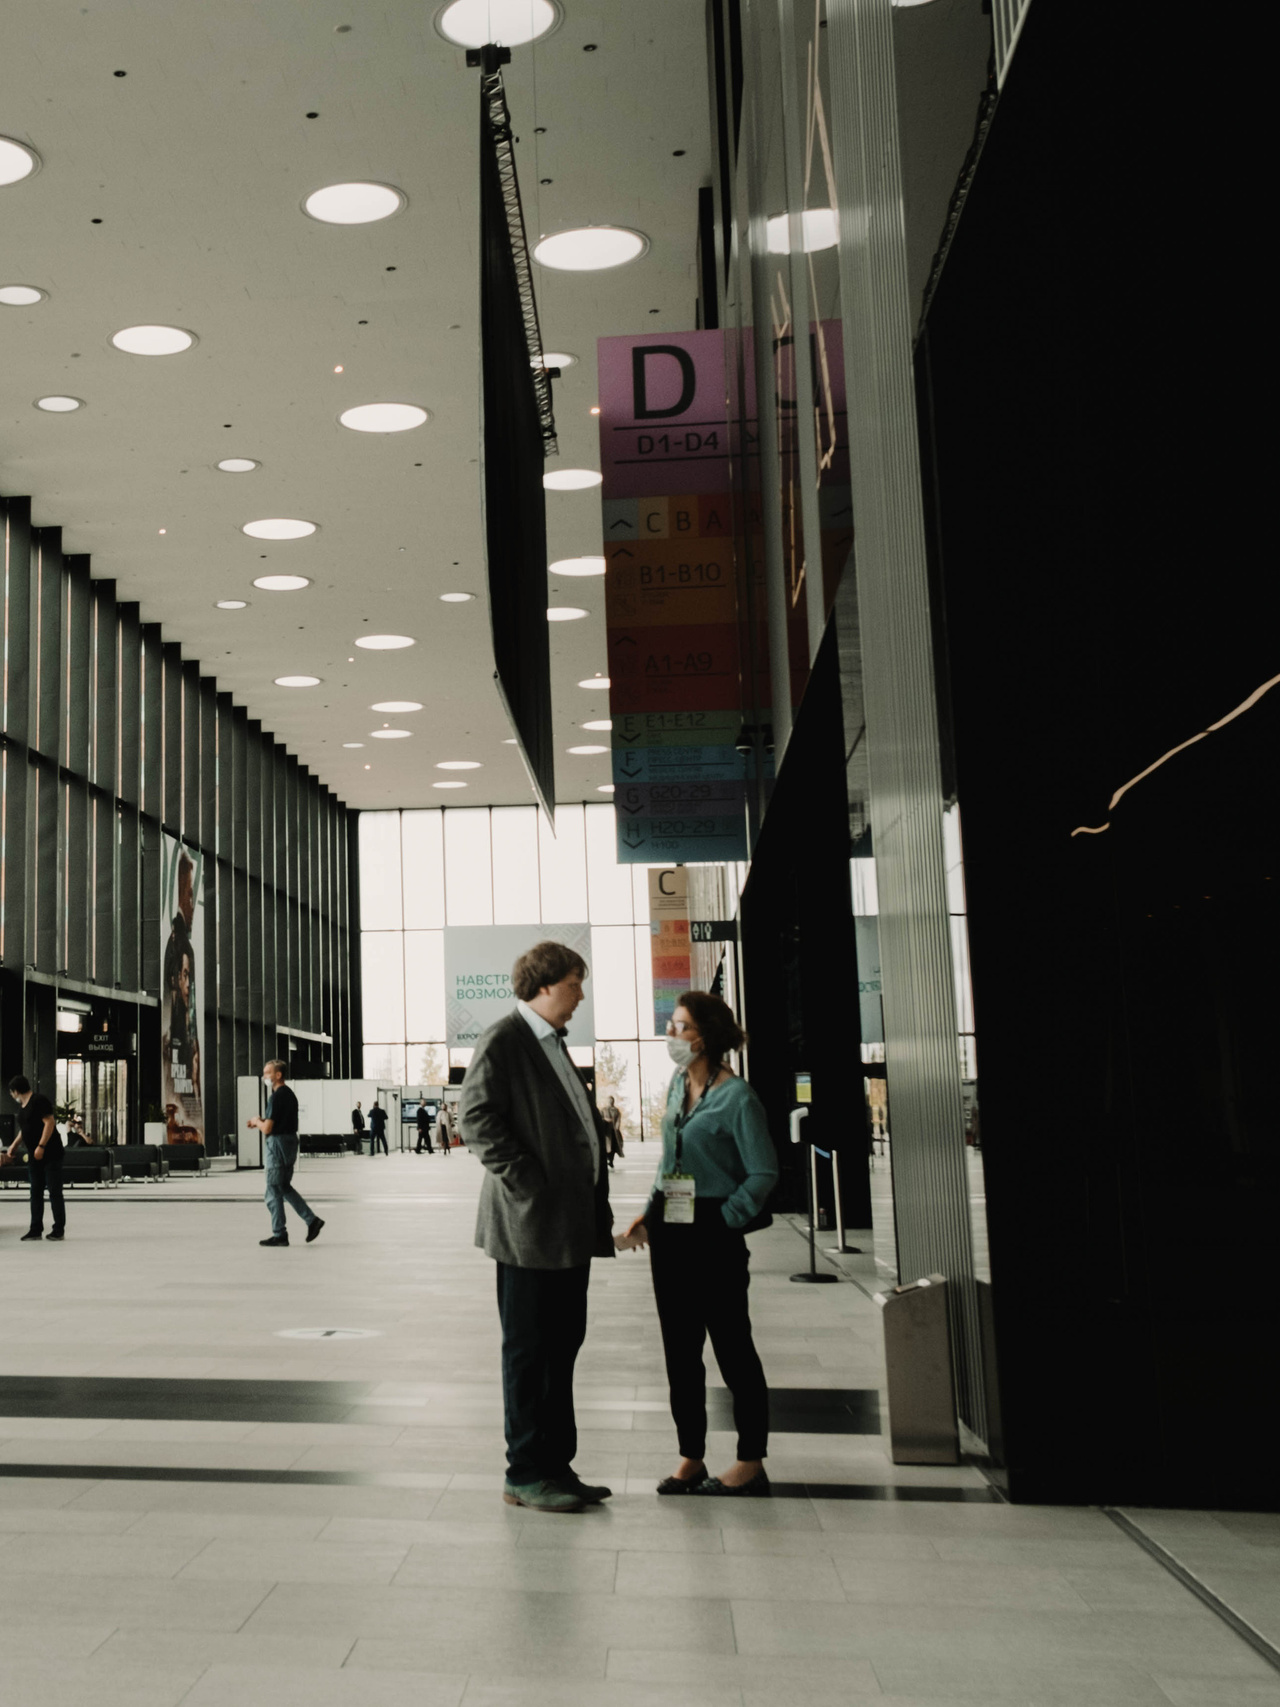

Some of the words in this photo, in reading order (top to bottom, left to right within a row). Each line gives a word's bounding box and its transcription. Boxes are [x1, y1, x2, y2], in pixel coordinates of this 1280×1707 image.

[632, 344, 696, 420] D
[638, 431, 719, 455] D1-D4
[647, 512, 661, 533] C
[676, 511, 691, 531] B
[706, 510, 723, 529] A
[640, 562, 721, 584] B1-B10
[645, 651, 713, 673] A1-A9
[624, 716, 634, 732] E
[646, 713, 706, 728] E1-E12
[626, 751, 636, 767] F
[627, 787, 639, 804] G
[649, 784, 712, 800] G20-29
[627, 823, 640, 838] H
[650, 819, 716, 835] H20-29
[658, 870, 676, 896] C
[456, 974, 515, 986] НАВСТР
[93, 1034, 110, 1042] EXIT
[88, 1043, 115, 1052] ВЫХОД
